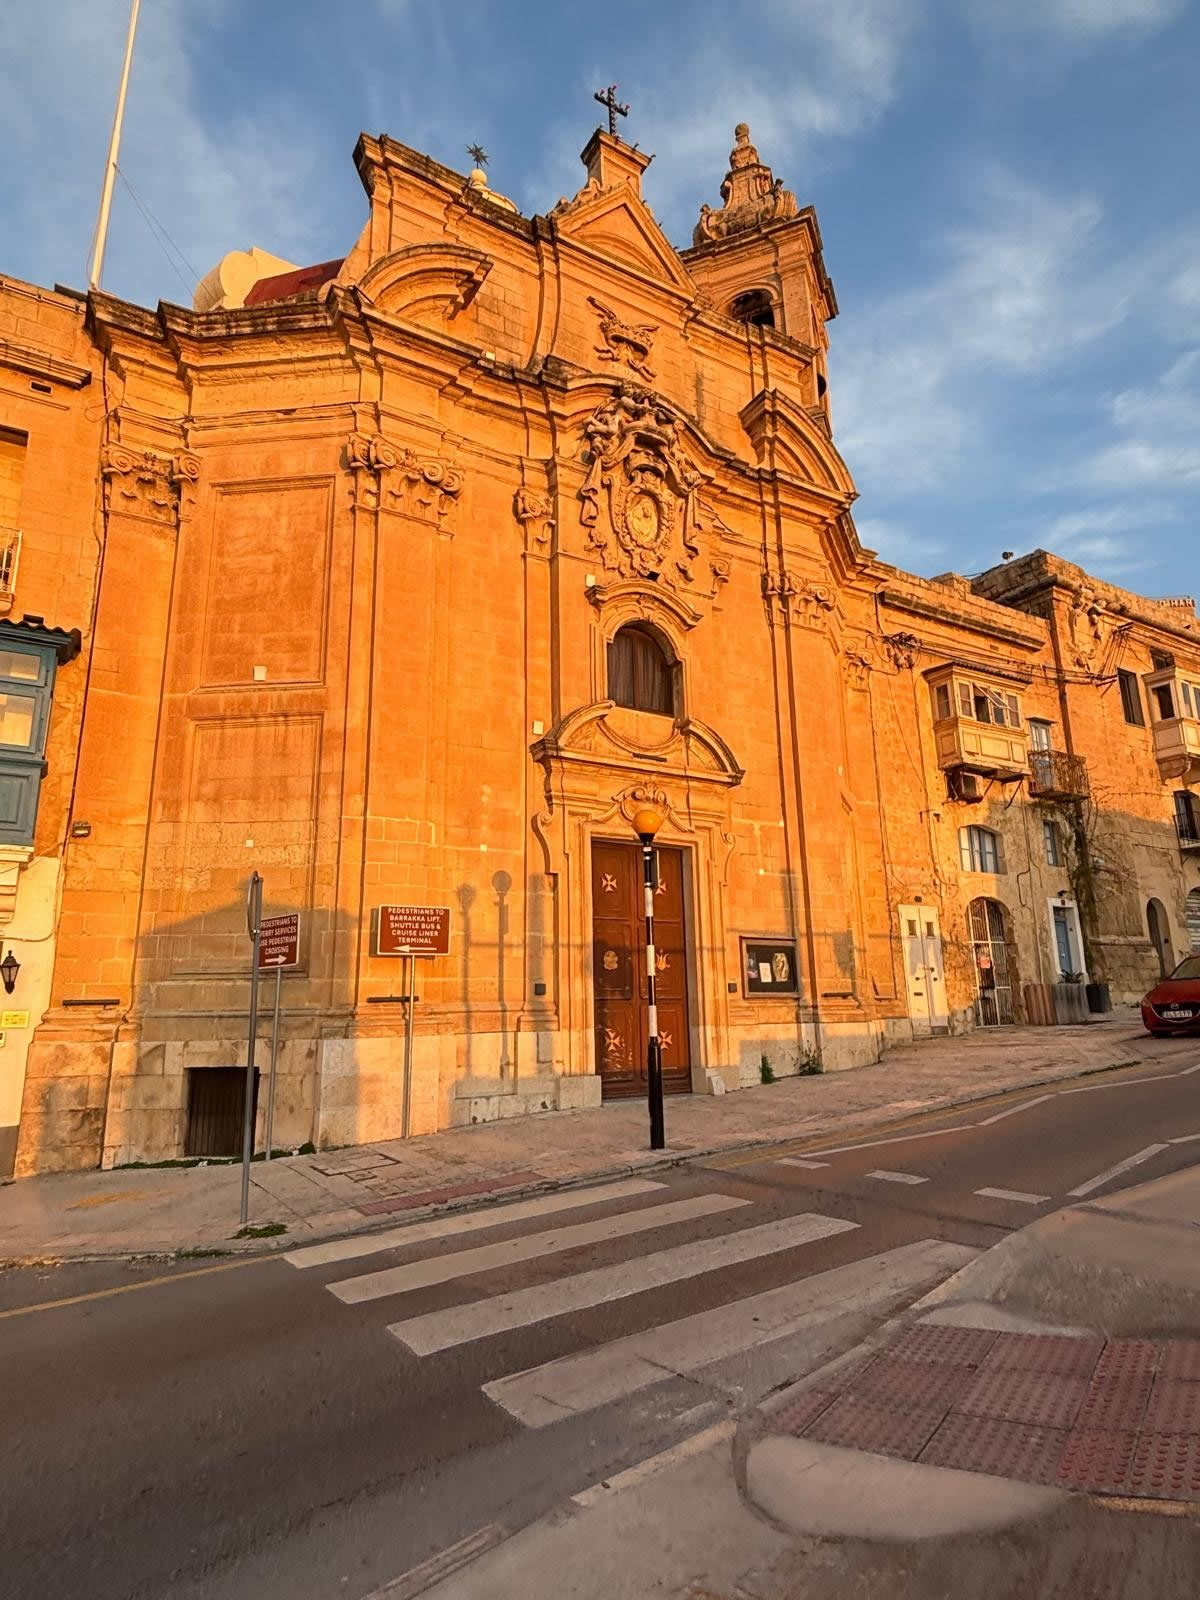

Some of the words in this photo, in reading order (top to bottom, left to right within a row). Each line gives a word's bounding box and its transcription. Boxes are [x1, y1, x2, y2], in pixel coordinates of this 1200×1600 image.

[274, 926, 296, 936] SERVICES
[269, 936, 296, 945] PEDESTRIAN
[265, 946, 288, 955] CROSSING
